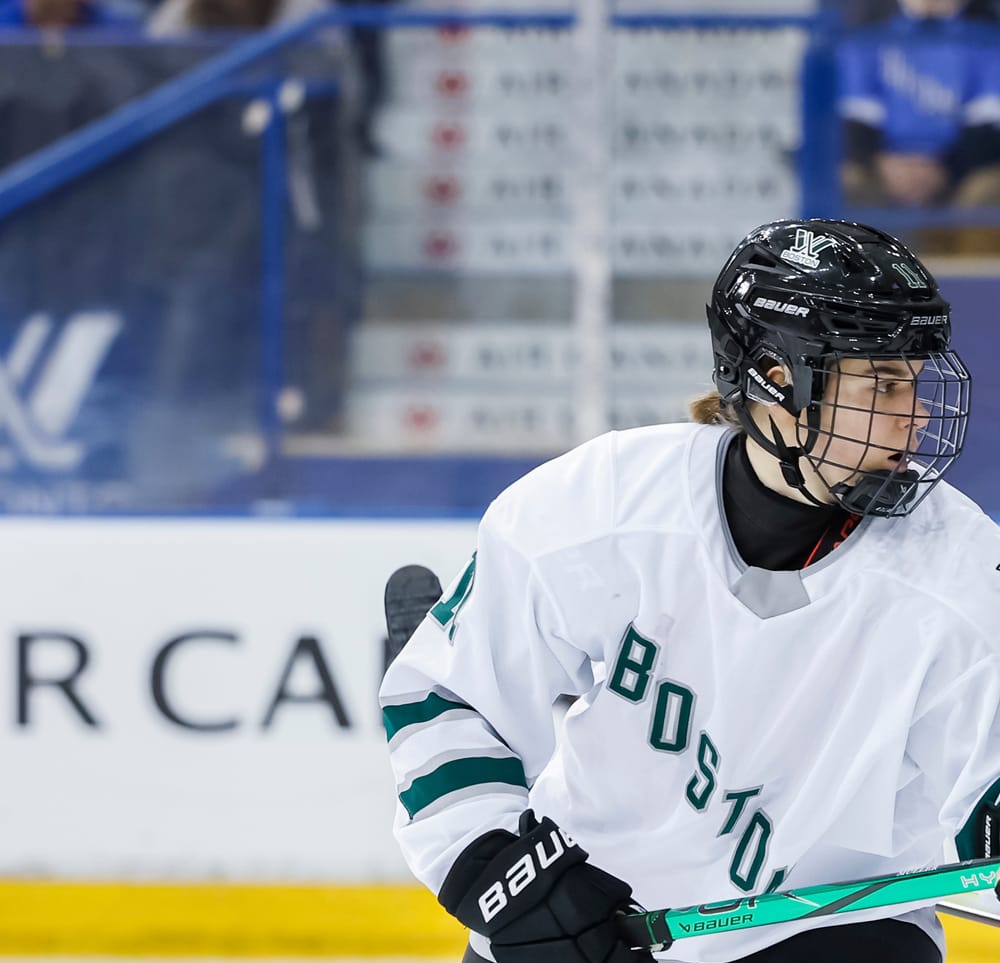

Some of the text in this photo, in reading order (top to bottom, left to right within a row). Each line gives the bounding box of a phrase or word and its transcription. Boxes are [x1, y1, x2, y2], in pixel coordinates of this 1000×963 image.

[781, 249, 819, 268] BOSTON
[892, 263, 928, 289] 11
[753, 297, 810, 318] BAUER
[909, 314, 948, 326] BAUER
[747, 367, 786, 402] BAUER
[693, 913, 754, 932] BAUER
